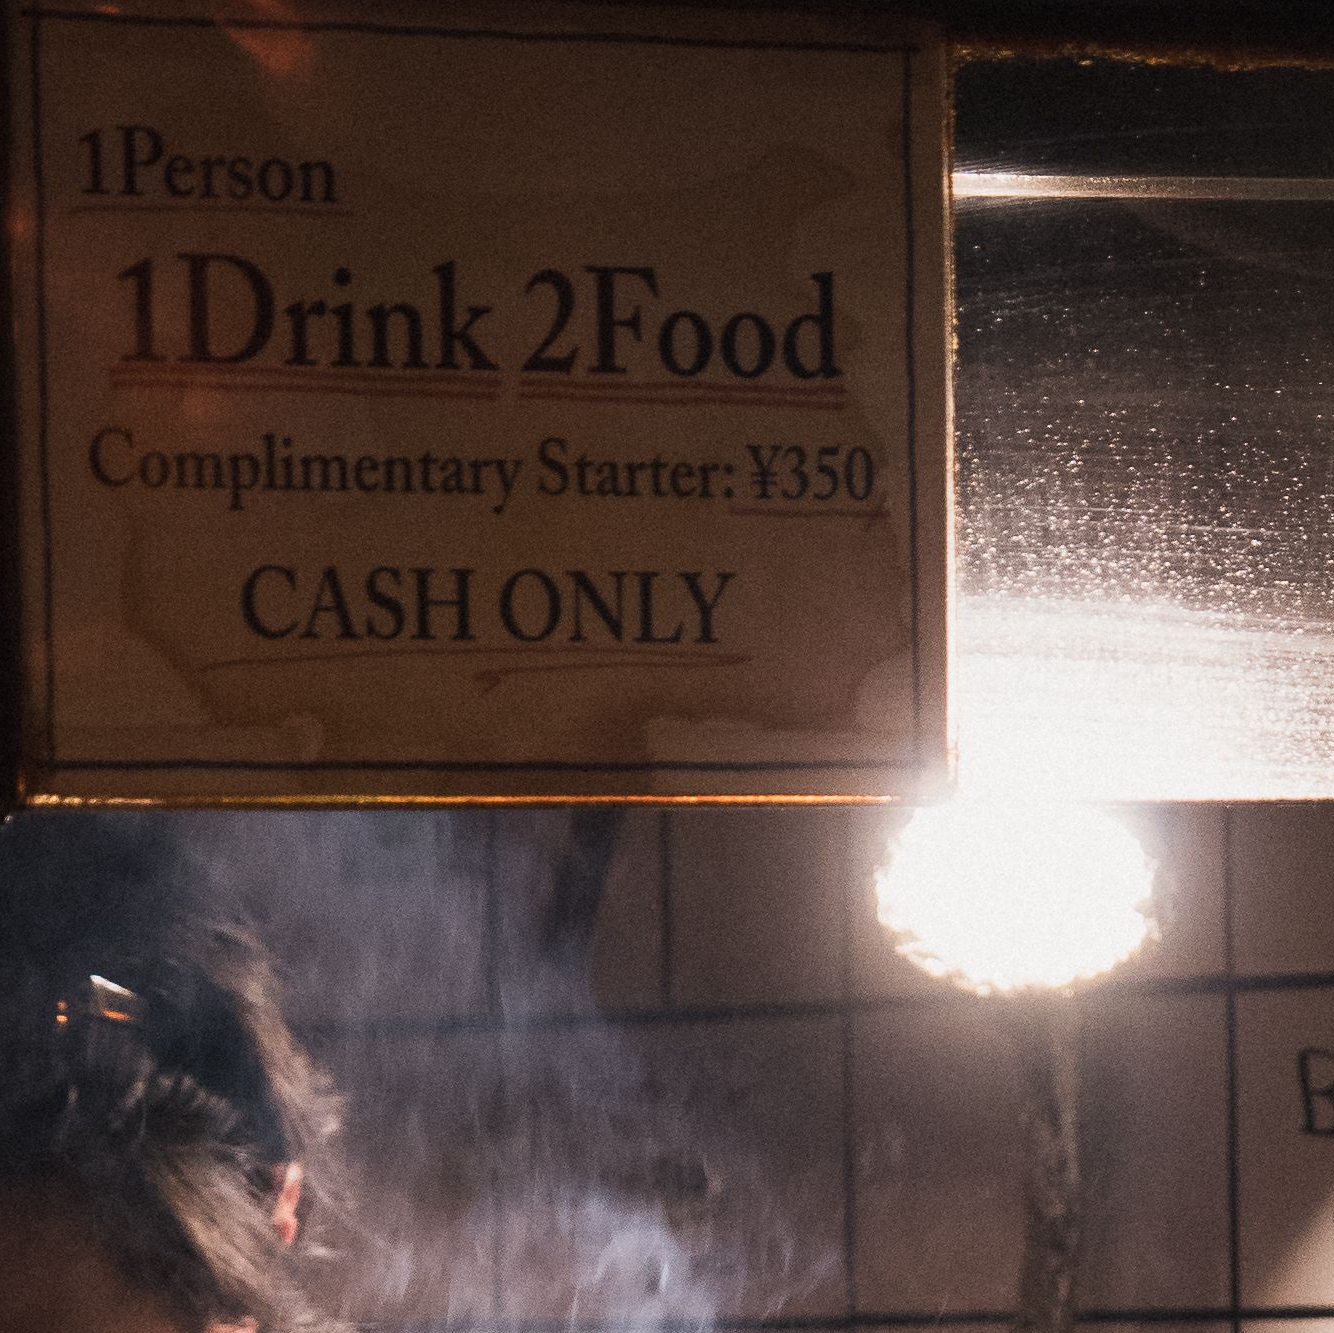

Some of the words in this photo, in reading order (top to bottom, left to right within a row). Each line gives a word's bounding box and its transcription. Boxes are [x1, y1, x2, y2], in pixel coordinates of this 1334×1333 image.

[78, 125, 338, 205] 1Person
[116, 253, 499, 373] 1Drink
[523, 264, 844, 380] 2Food
[88, 427, 522, 514] Complimentary
[240, 564, 492, 641] CASH
[497, 567, 735, 645] ONLY
